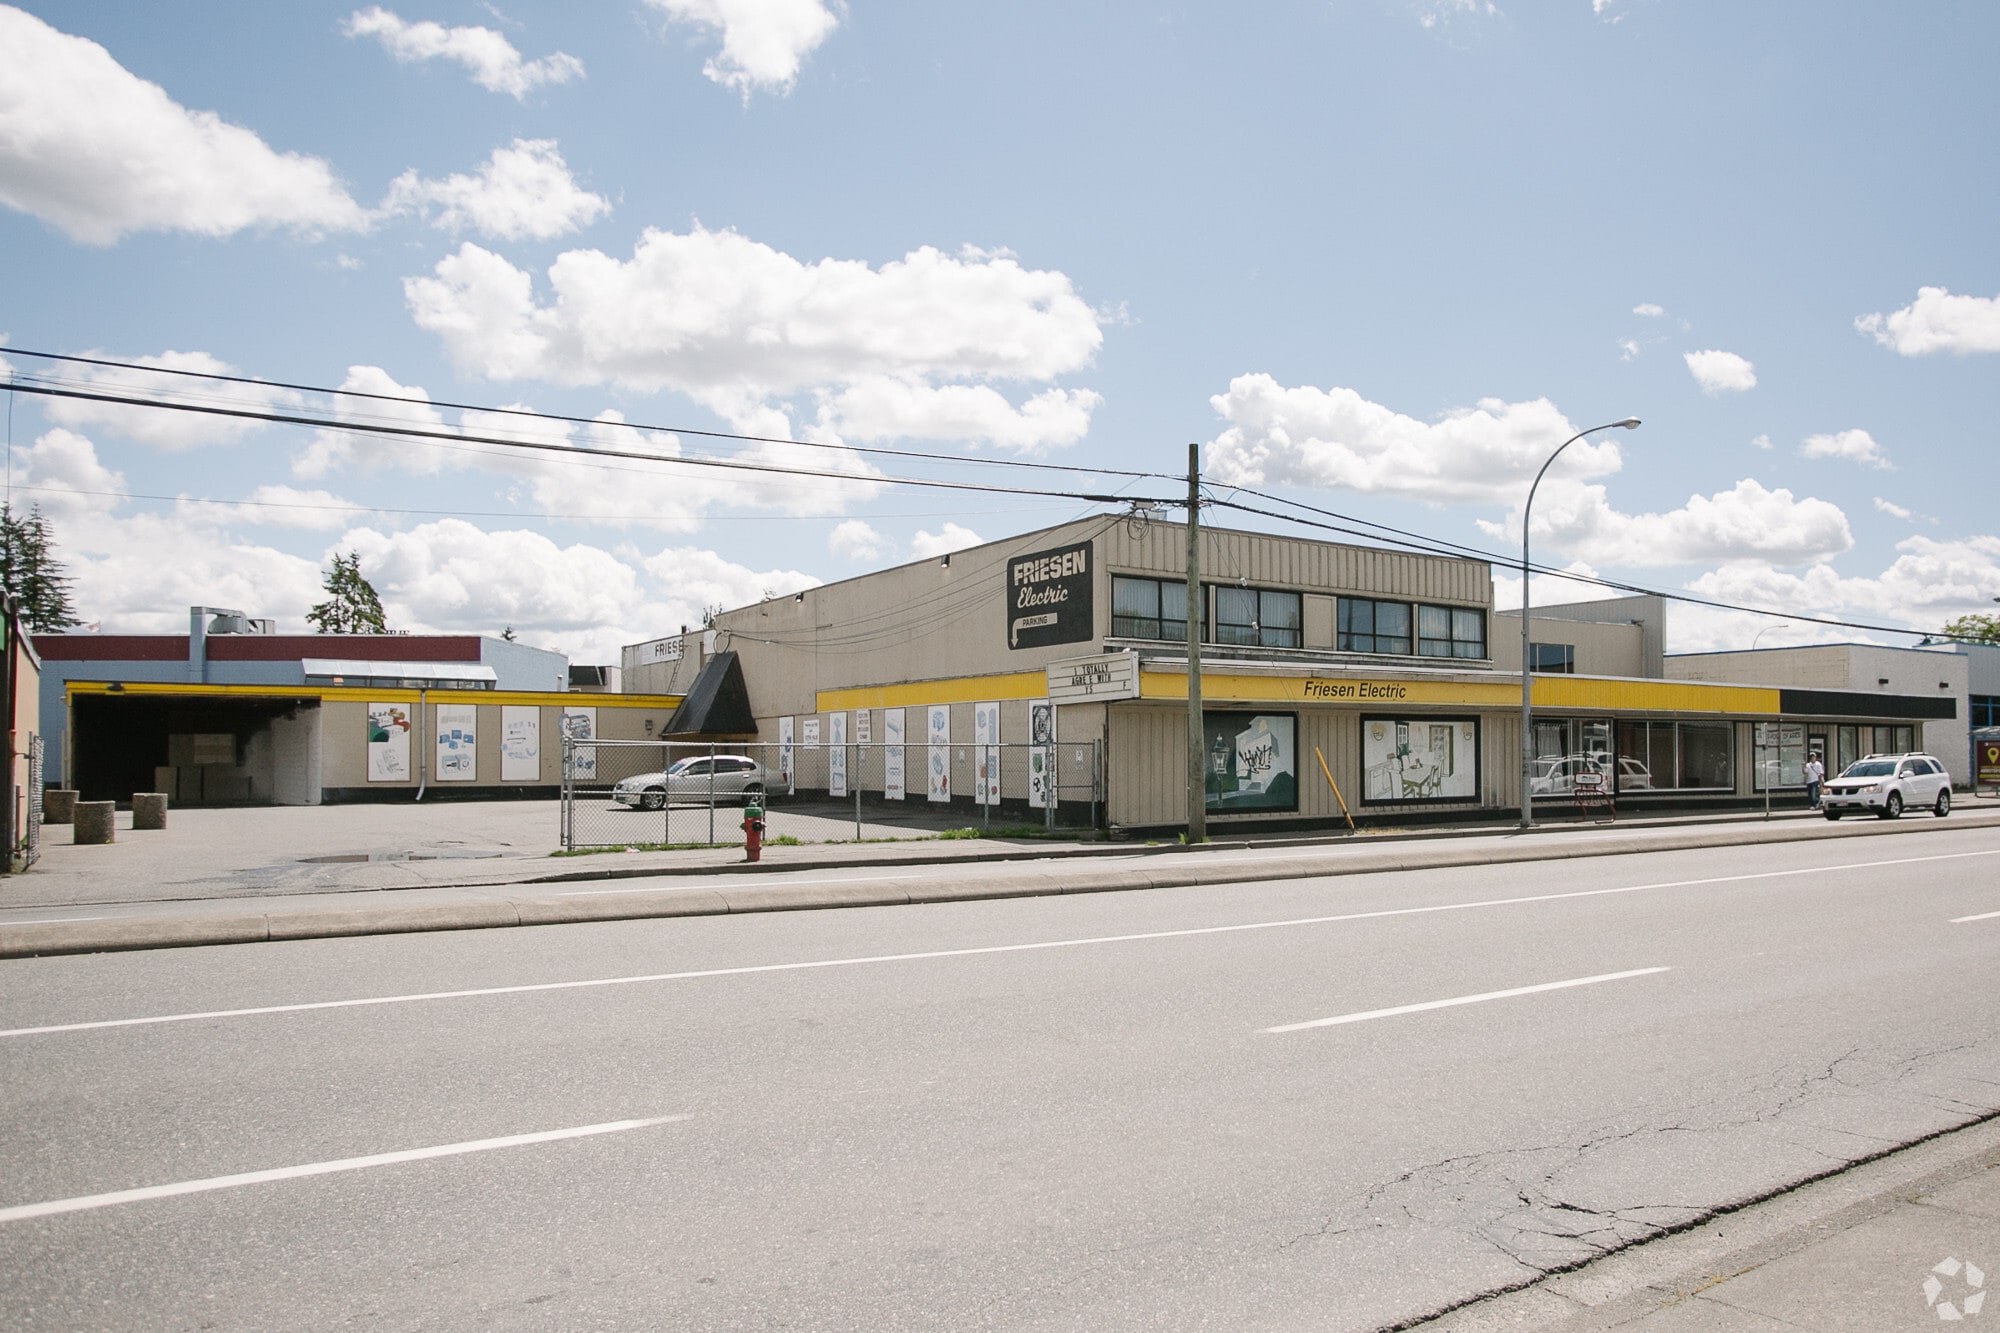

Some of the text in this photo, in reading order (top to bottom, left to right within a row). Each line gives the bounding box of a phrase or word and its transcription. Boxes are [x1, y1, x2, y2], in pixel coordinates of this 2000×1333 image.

[1013, 549, 1086, 586] FRIESEN
[1017, 584, 1069, 609] Electric
[1022, 615, 1048, 627] PARKING
[1082, 663, 1109, 676] TOTALLY
[1097, 673, 1111, 683] WITH
[1303, 681, 1406, 699] Friesen Electric
